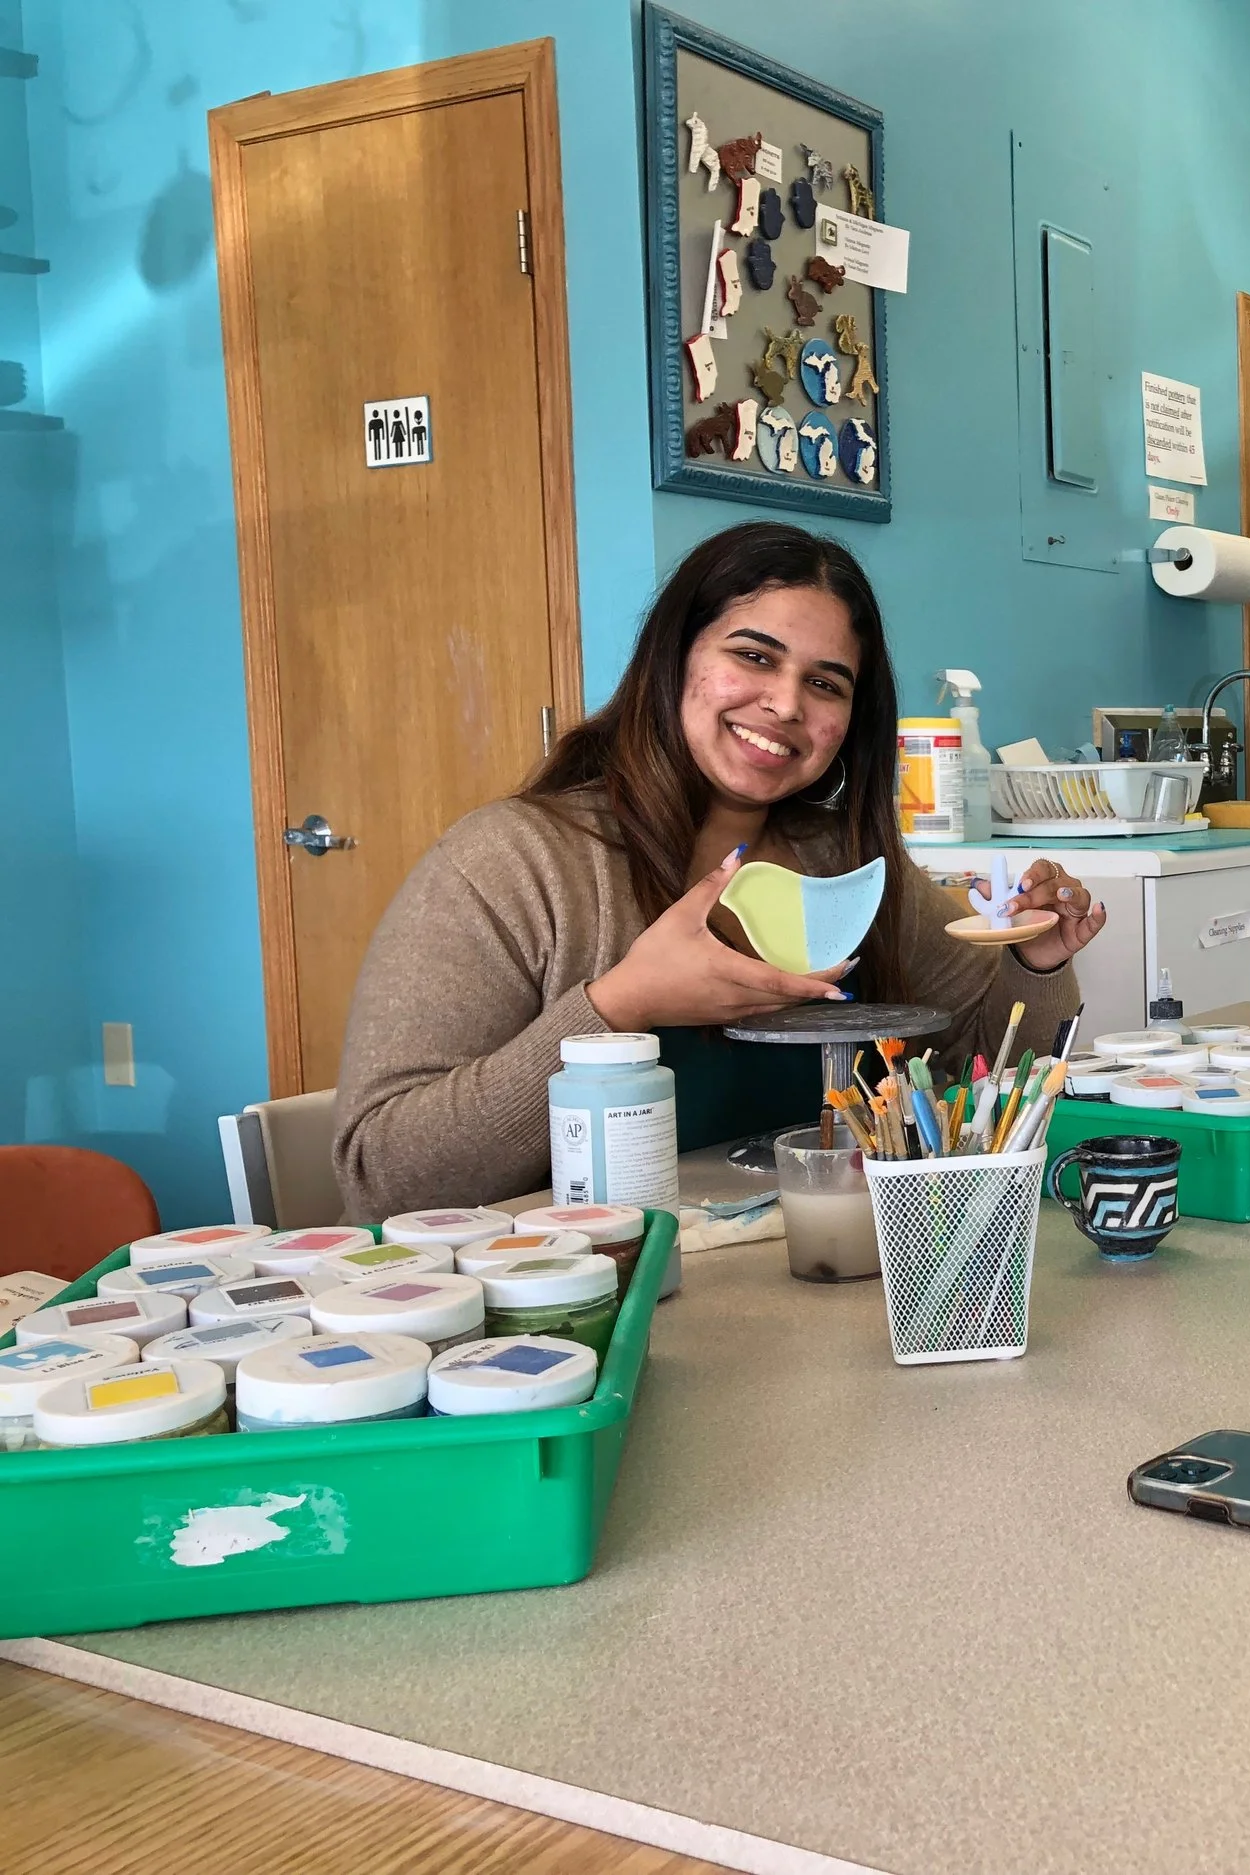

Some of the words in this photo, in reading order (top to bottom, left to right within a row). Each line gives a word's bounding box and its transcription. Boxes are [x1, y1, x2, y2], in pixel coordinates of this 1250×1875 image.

[1144, 381, 1168, 397] Finished
[1186, 394, 1197, 405] that
[1151, 402, 1160, 412] not
[1175, 425, 1185, 436] will
[1185, 427, 1192, 437] be
[607, 1111, 622, 1119] ART
[623, 1110, 632, 1118] IN
[566, 1123, 582, 1138] AP
